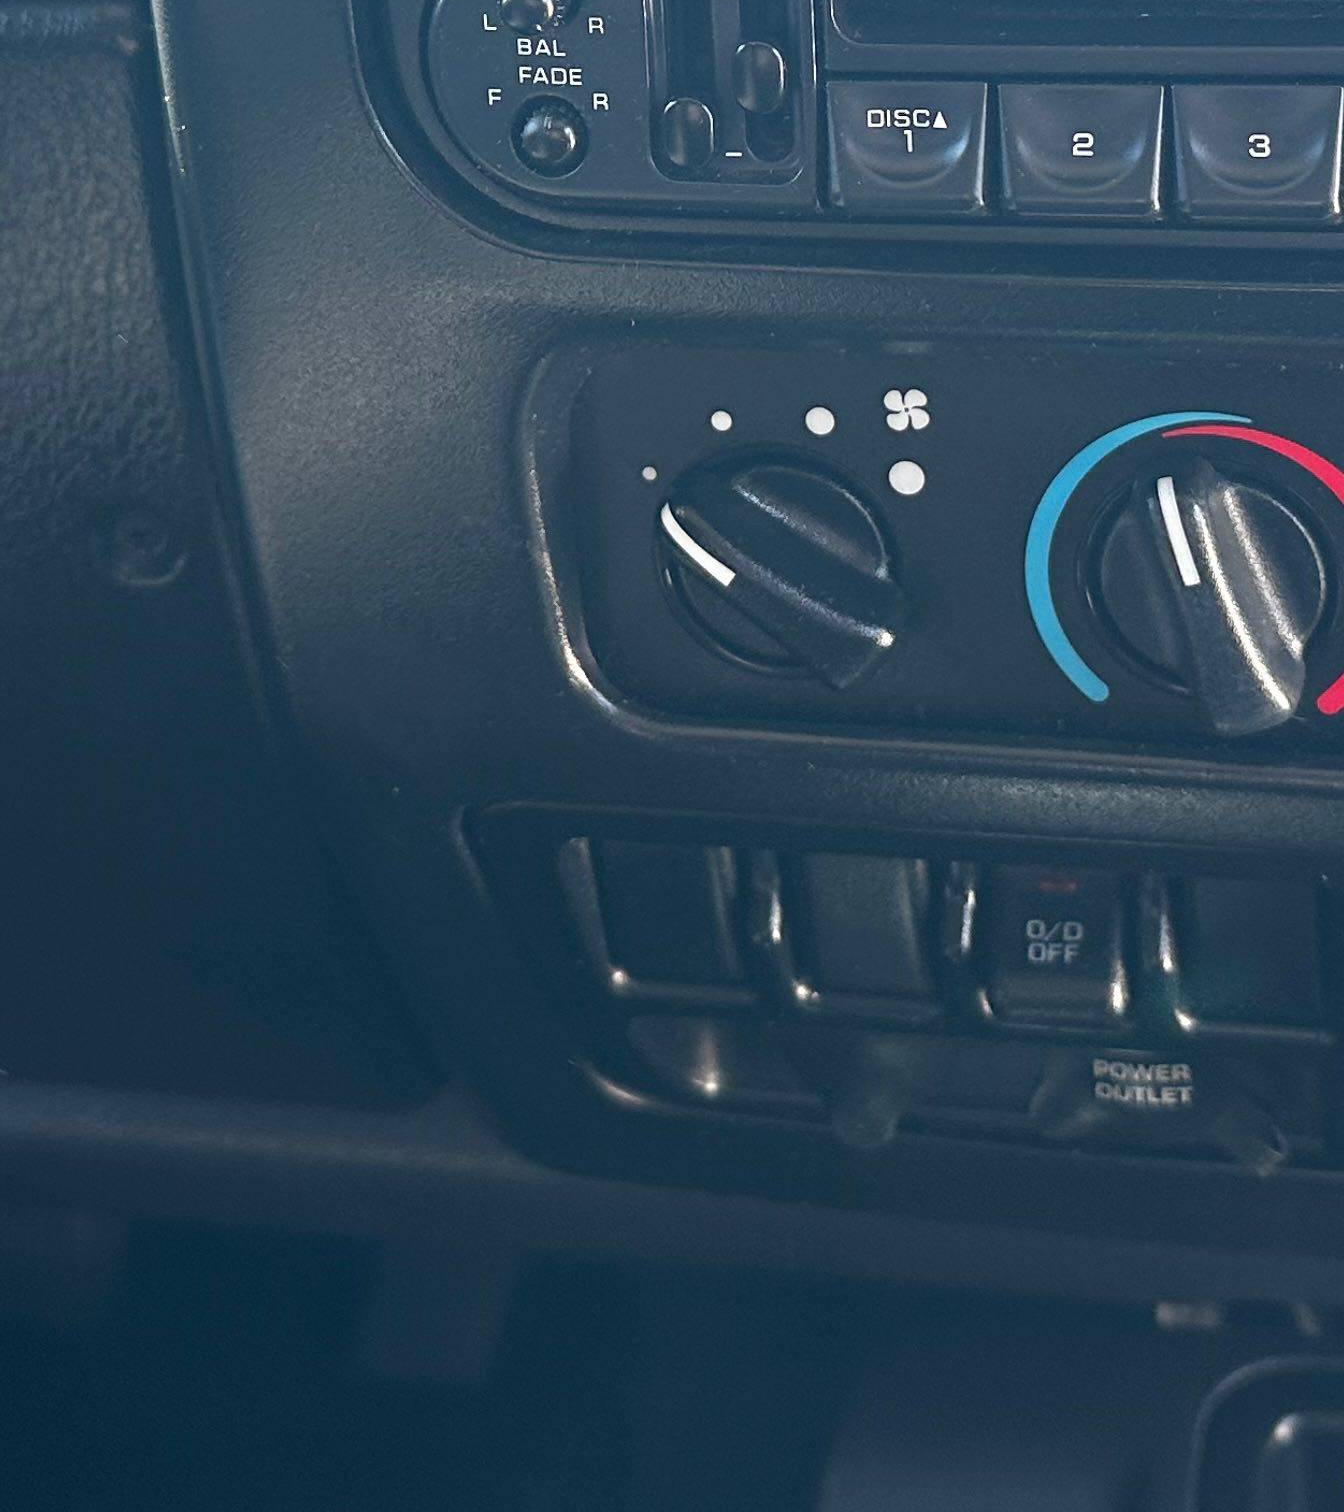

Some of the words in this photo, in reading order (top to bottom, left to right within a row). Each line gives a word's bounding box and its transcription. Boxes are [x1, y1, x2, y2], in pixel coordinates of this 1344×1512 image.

[483, 14, 498, 32] L
[588, 17, 604, 34] R
[517, 39, 567, 57] BAL
[518, 67, 583, 86] FADE
[487, 89, 502, 106] F
[592, 92, 609, 110] R
[867, 109, 930, 130] DISC
[902, 131, 914, 153] 1
[1071, 133, 1095, 157] 2
[1248, 134, 1272, 158] 3
[1026, 919, 1084, 941] O/D
[1027, 941, 1080, 965] OFF
[1093, 1058, 1192, 1081] POWER
[1094, 1082, 1194, 1107] OUTLET
